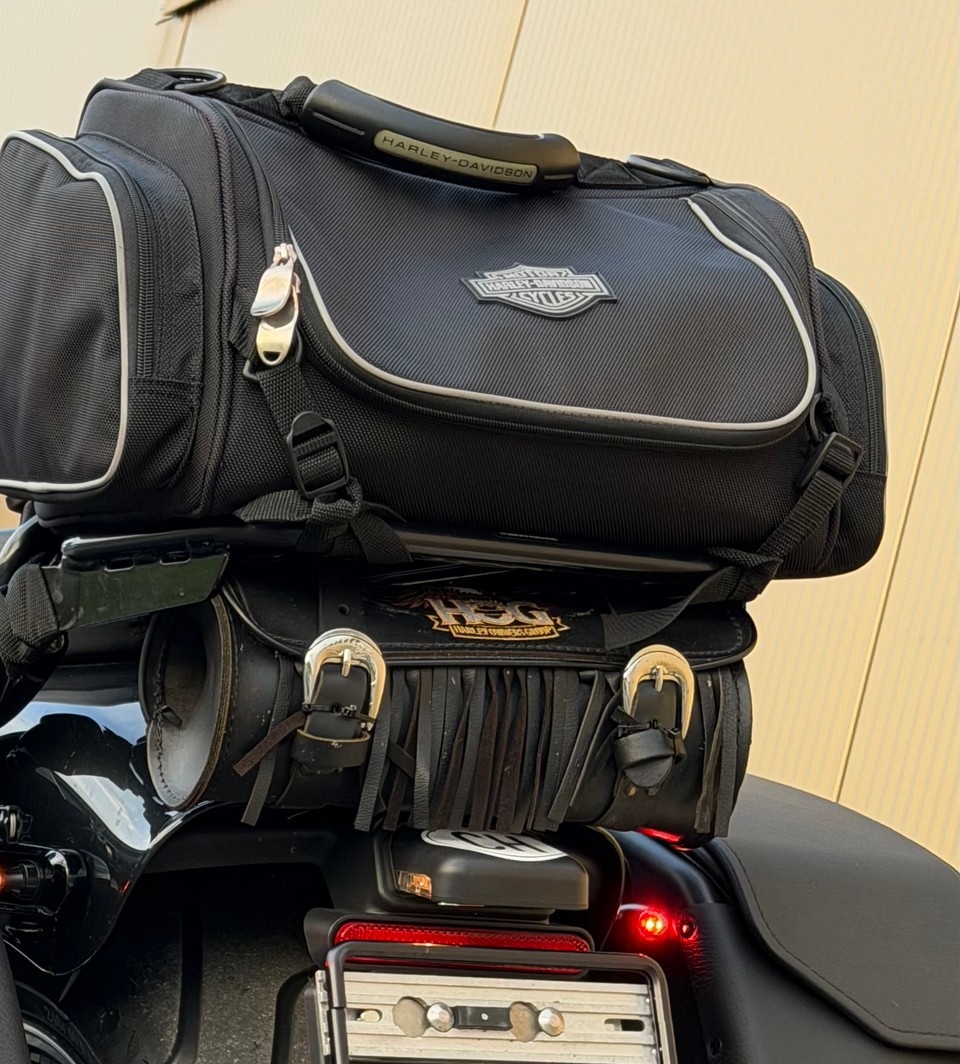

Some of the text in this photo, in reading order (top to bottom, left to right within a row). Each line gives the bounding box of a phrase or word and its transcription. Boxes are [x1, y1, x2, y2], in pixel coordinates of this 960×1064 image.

[381, 135, 534, 180] HARLEY-DAVIDSON
[485, 279, 594, 291] HARLEY-DAVIDSON
[519, 291, 577, 306] CYCLES
[451, 831, 547, 854] CH
